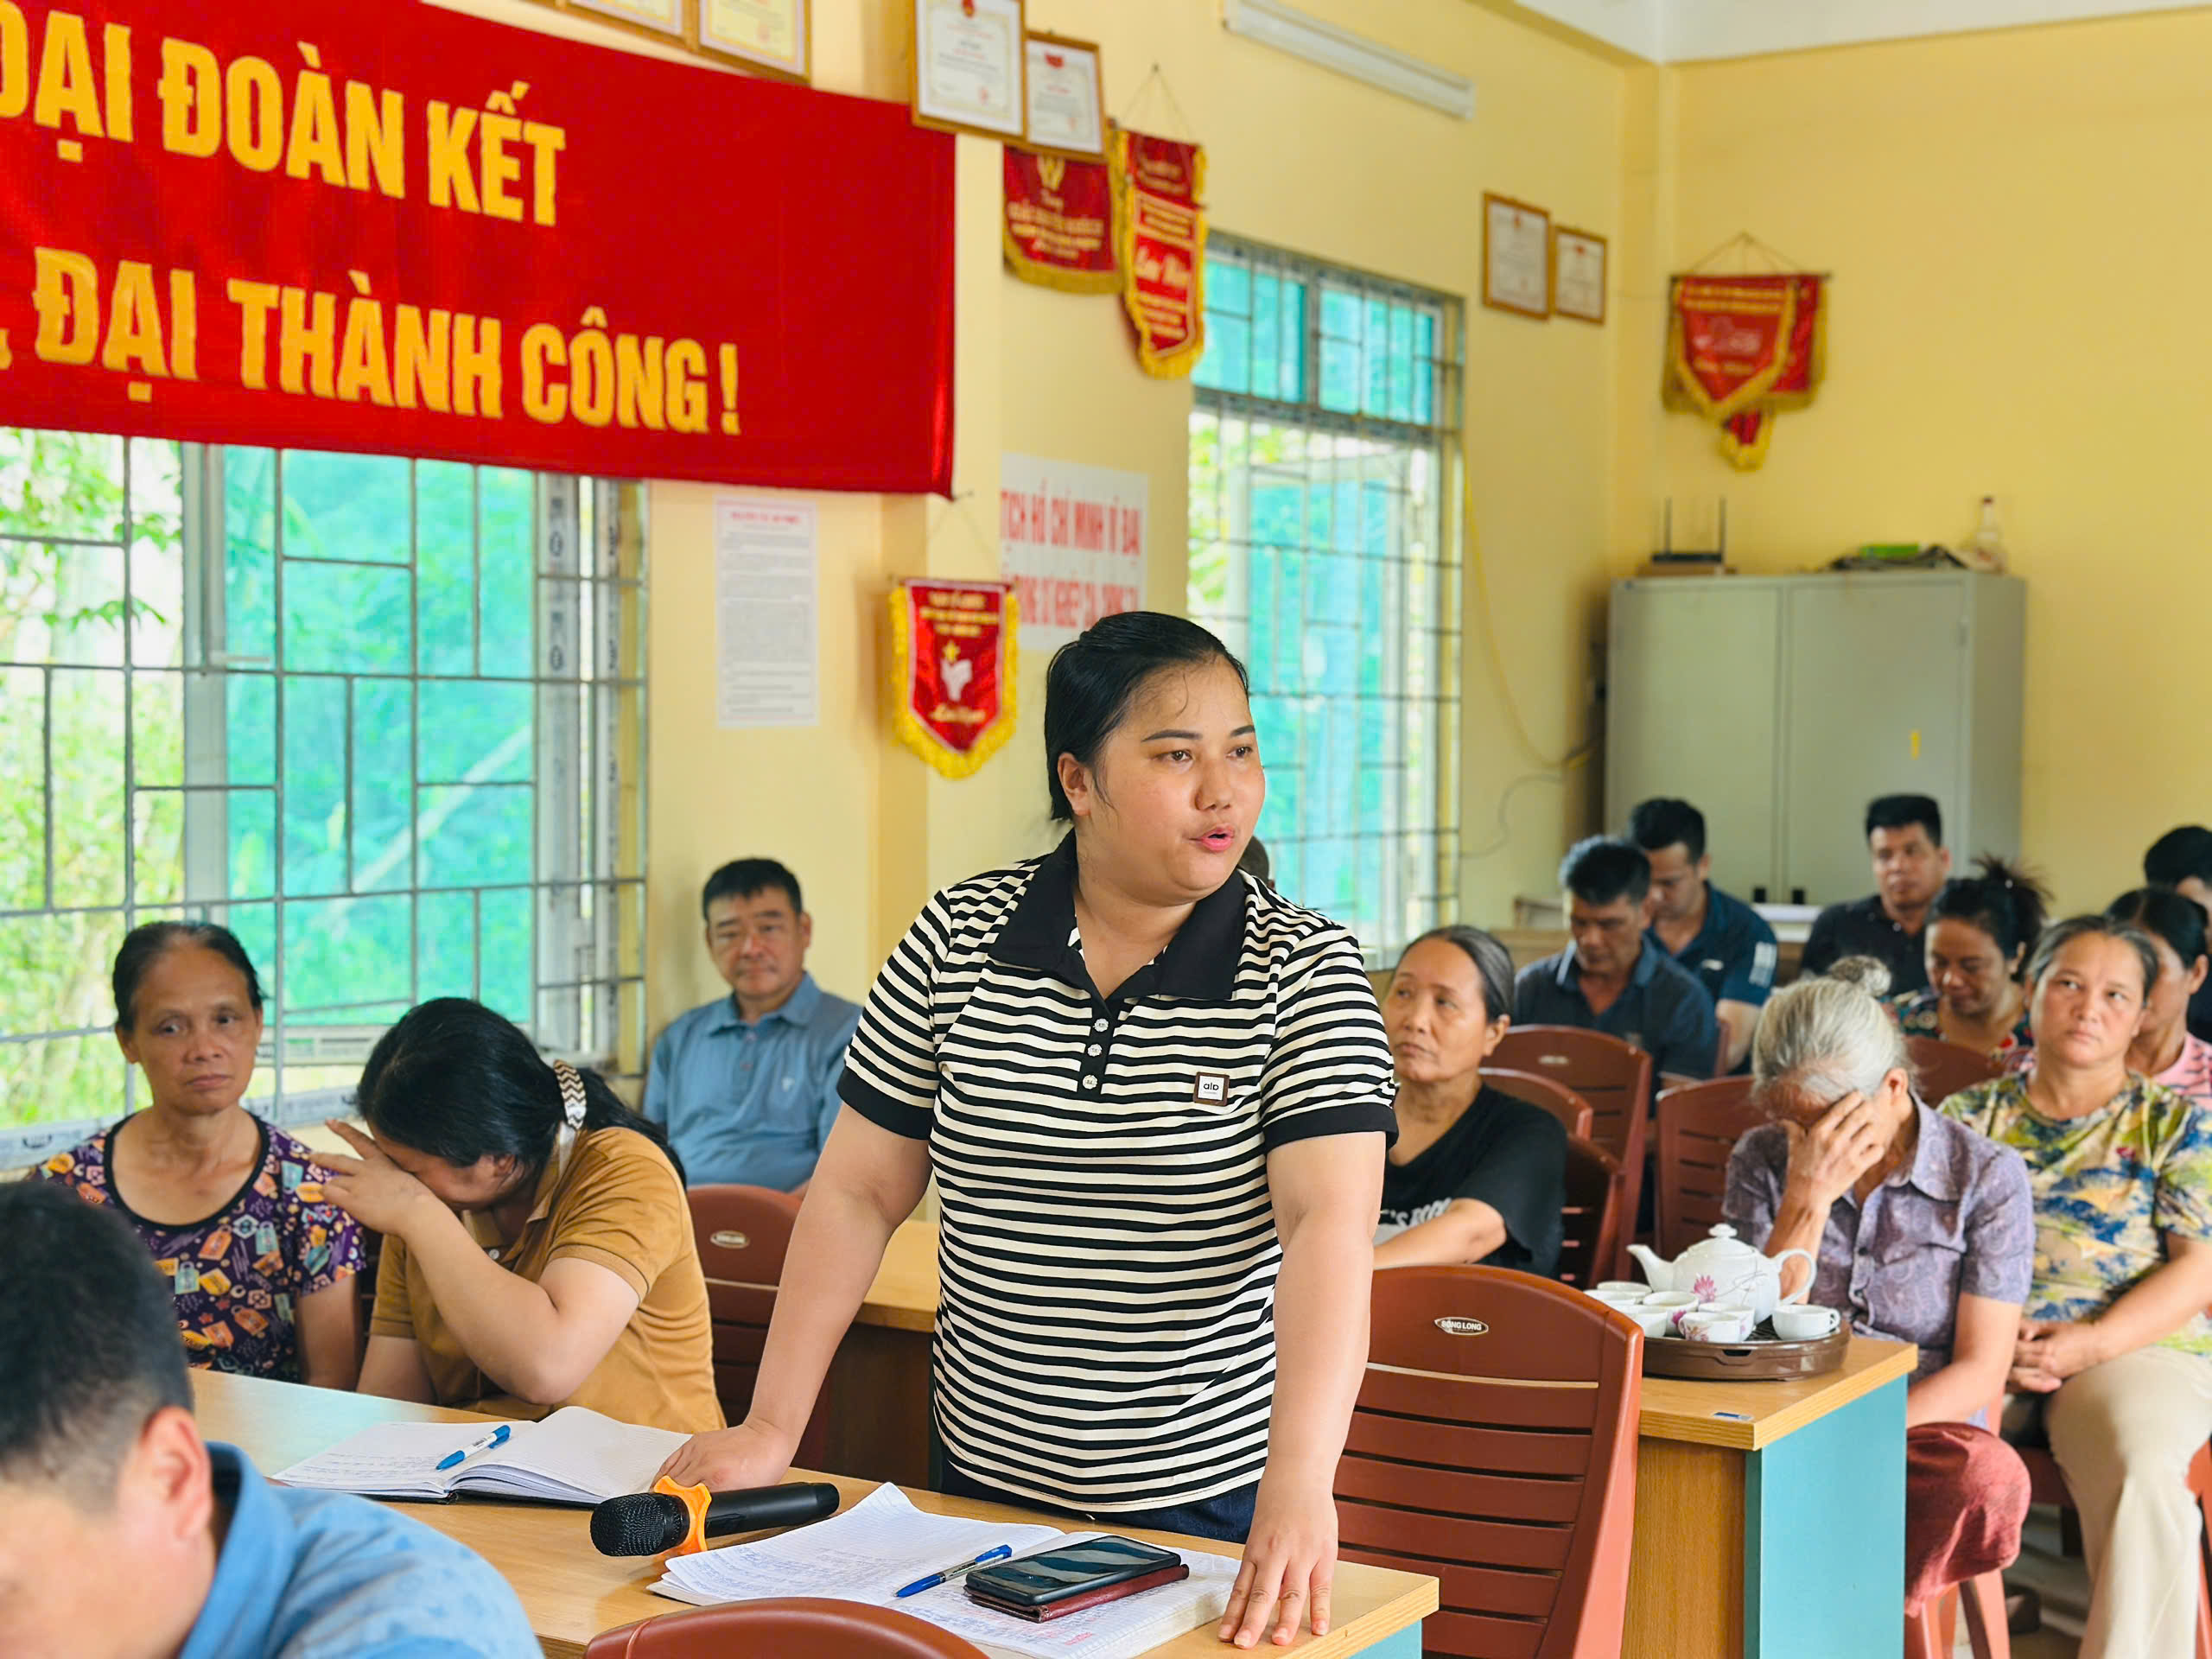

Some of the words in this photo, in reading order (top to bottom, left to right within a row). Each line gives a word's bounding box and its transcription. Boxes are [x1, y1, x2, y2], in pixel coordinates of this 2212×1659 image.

[158, 41, 405, 200] ĐOÀN
[426, 80, 566, 226] KẾT
[31, 246, 198, 403] ĐẠI
[226, 270, 504, 420] THÀNH
[1462, 1322, 1482, 1332] LONG
